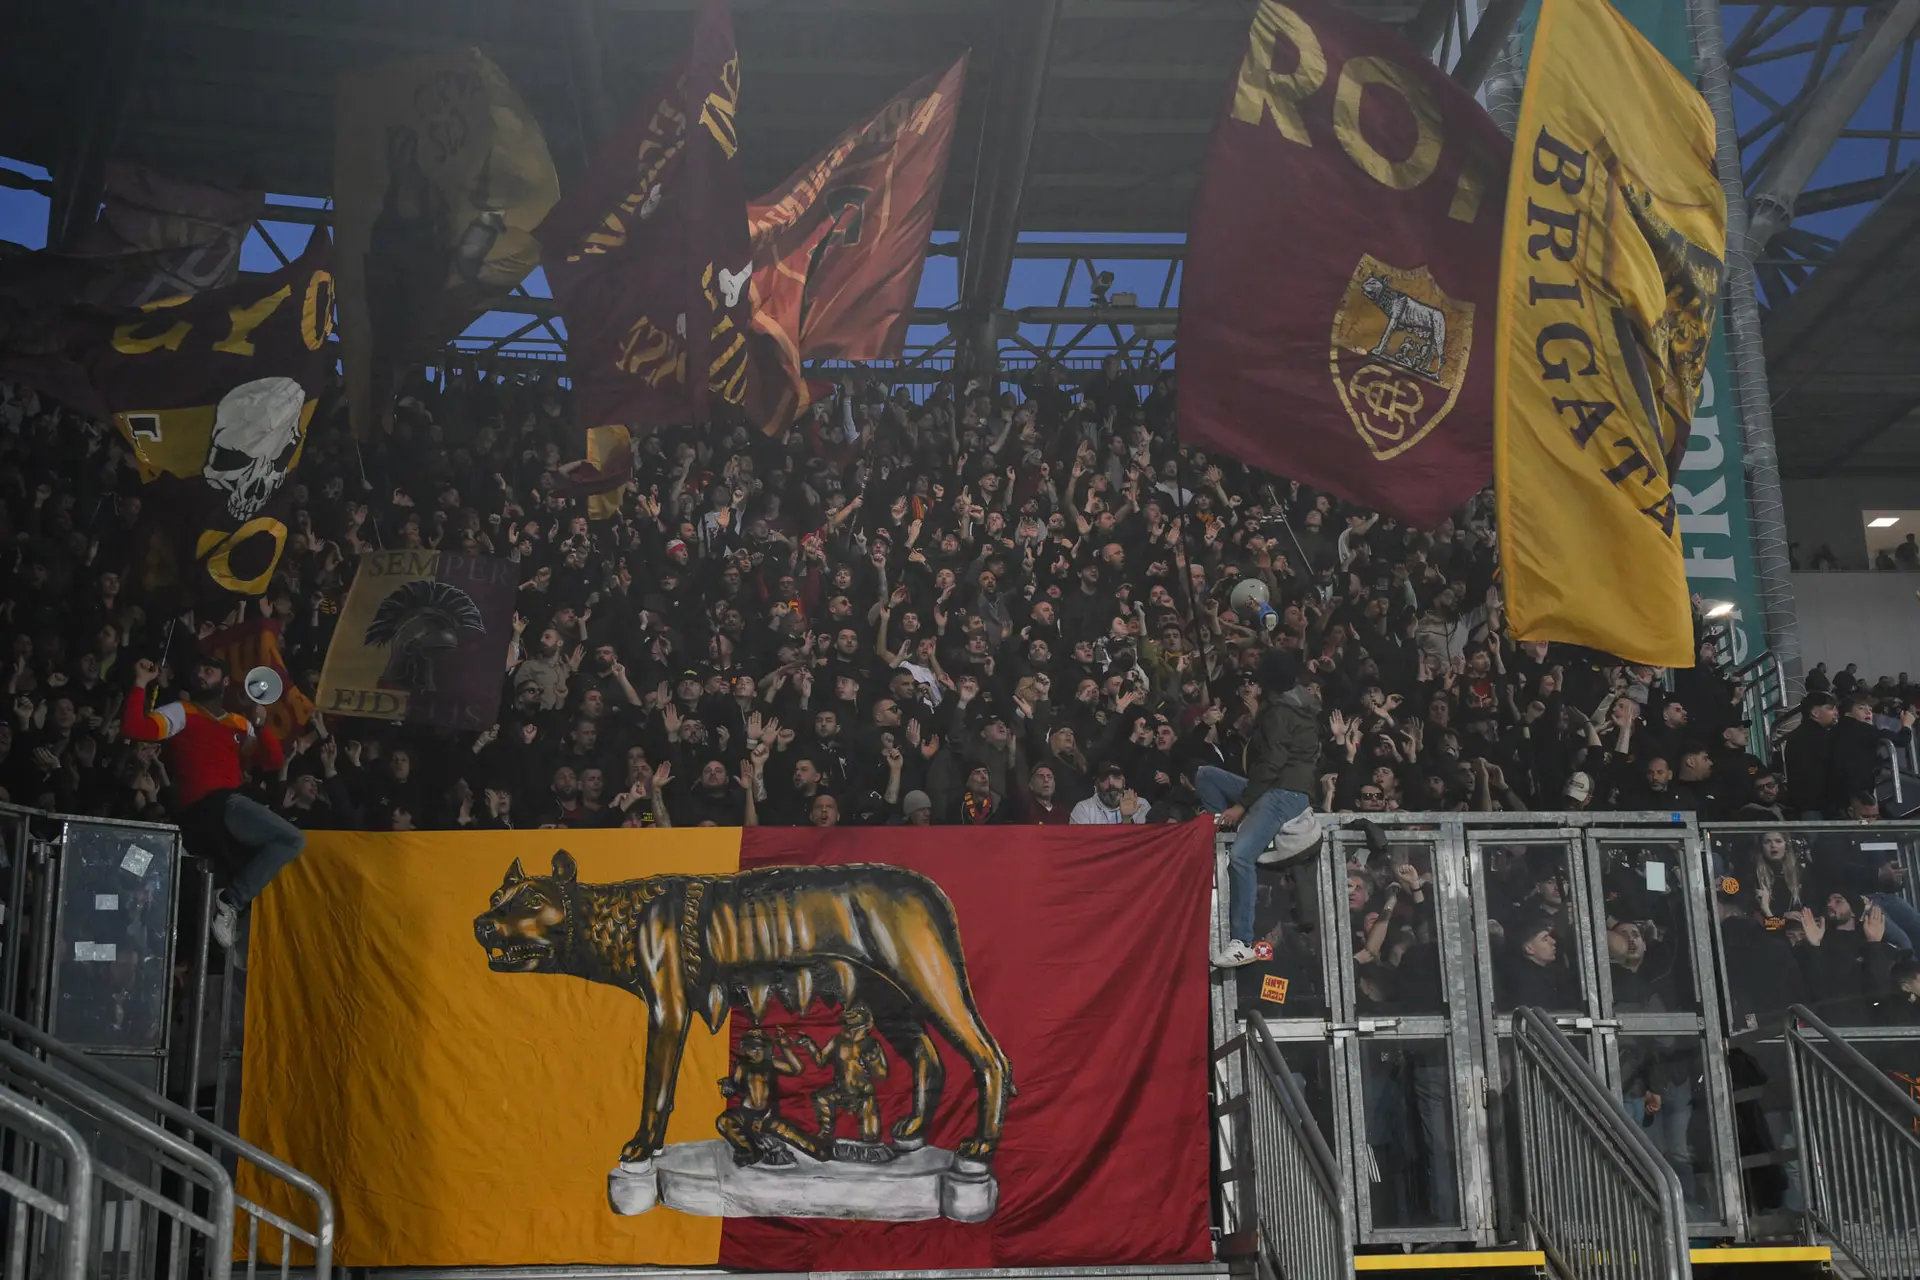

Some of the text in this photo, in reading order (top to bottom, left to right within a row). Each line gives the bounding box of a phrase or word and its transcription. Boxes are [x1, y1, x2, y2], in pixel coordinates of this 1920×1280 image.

[1231, 0, 1485, 224] RO
[1528, 124, 1678, 539] BRIGATA
[368, 551, 508, 585] SEMPER
[329, 688, 483, 728] FIDLIS
